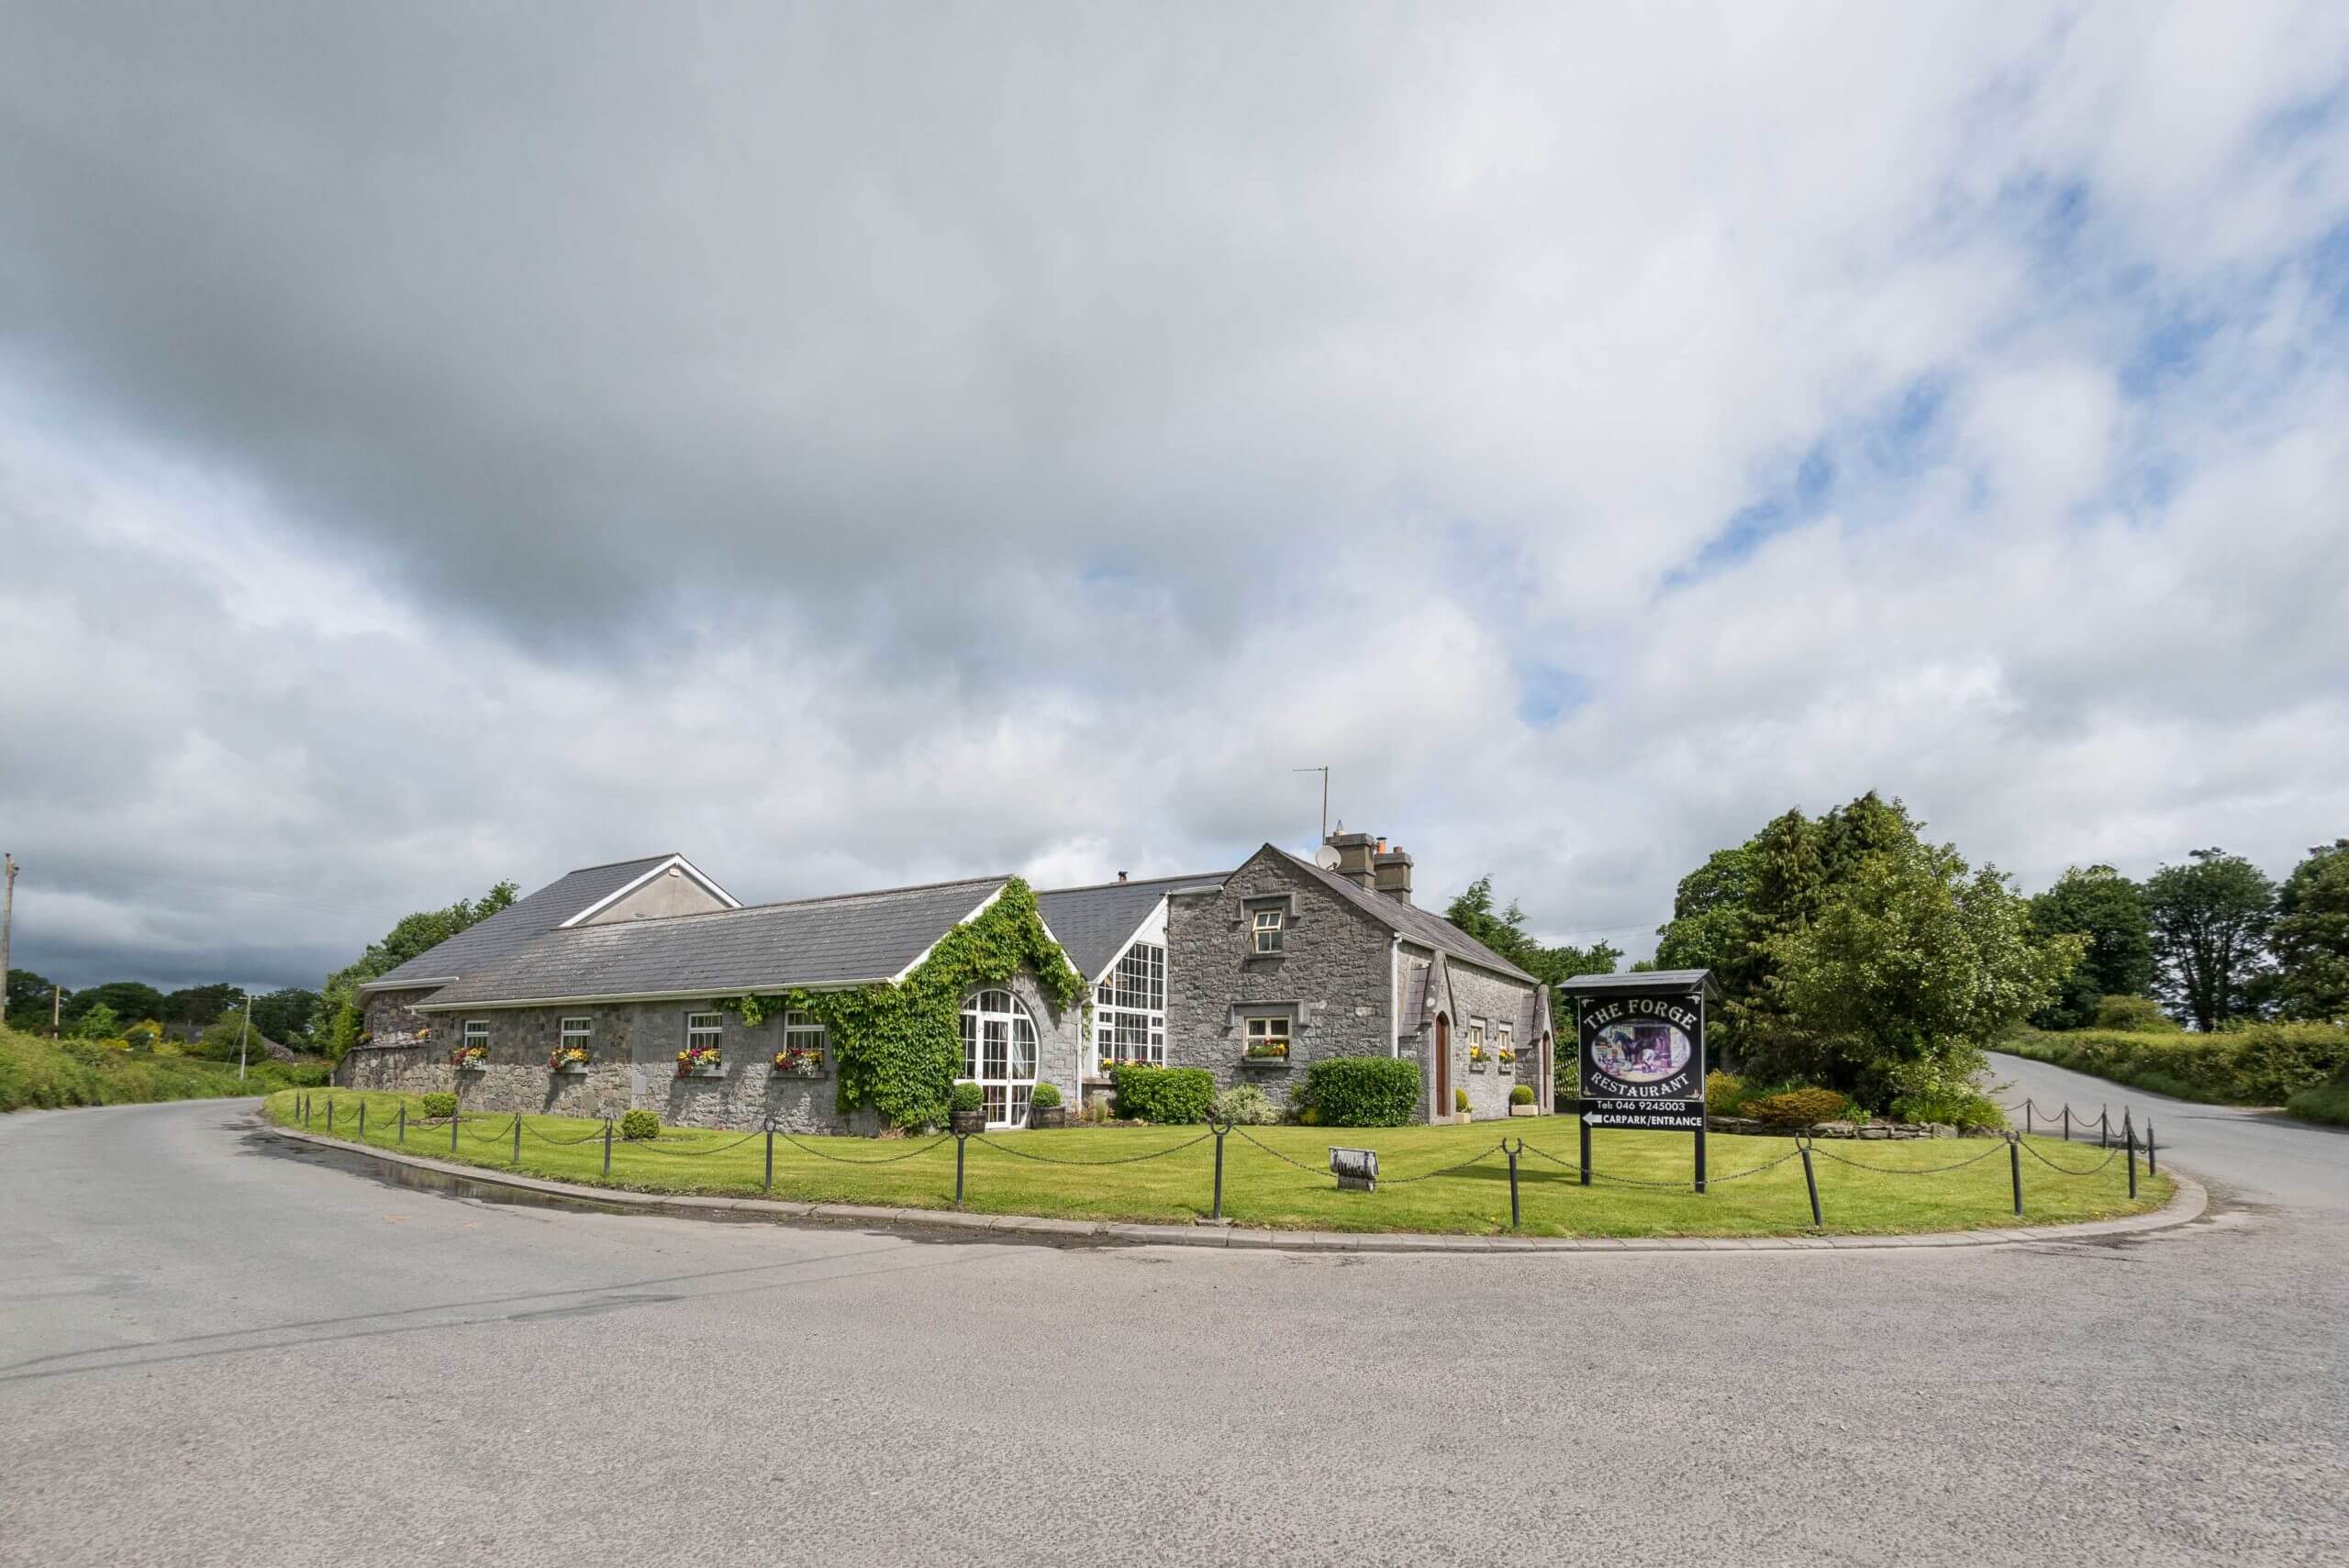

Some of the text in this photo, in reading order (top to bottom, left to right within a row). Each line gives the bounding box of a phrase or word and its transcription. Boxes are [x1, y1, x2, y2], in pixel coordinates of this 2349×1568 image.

[1584, 999, 1698, 1030] THE FORGE
[1590, 1072, 1689, 1097] RESTAURANT
[1597, 1101, 1686, 1111] Tel: 046 9245003
[1603, 1114, 1702, 1127] CARPARK/ENTRANCE
